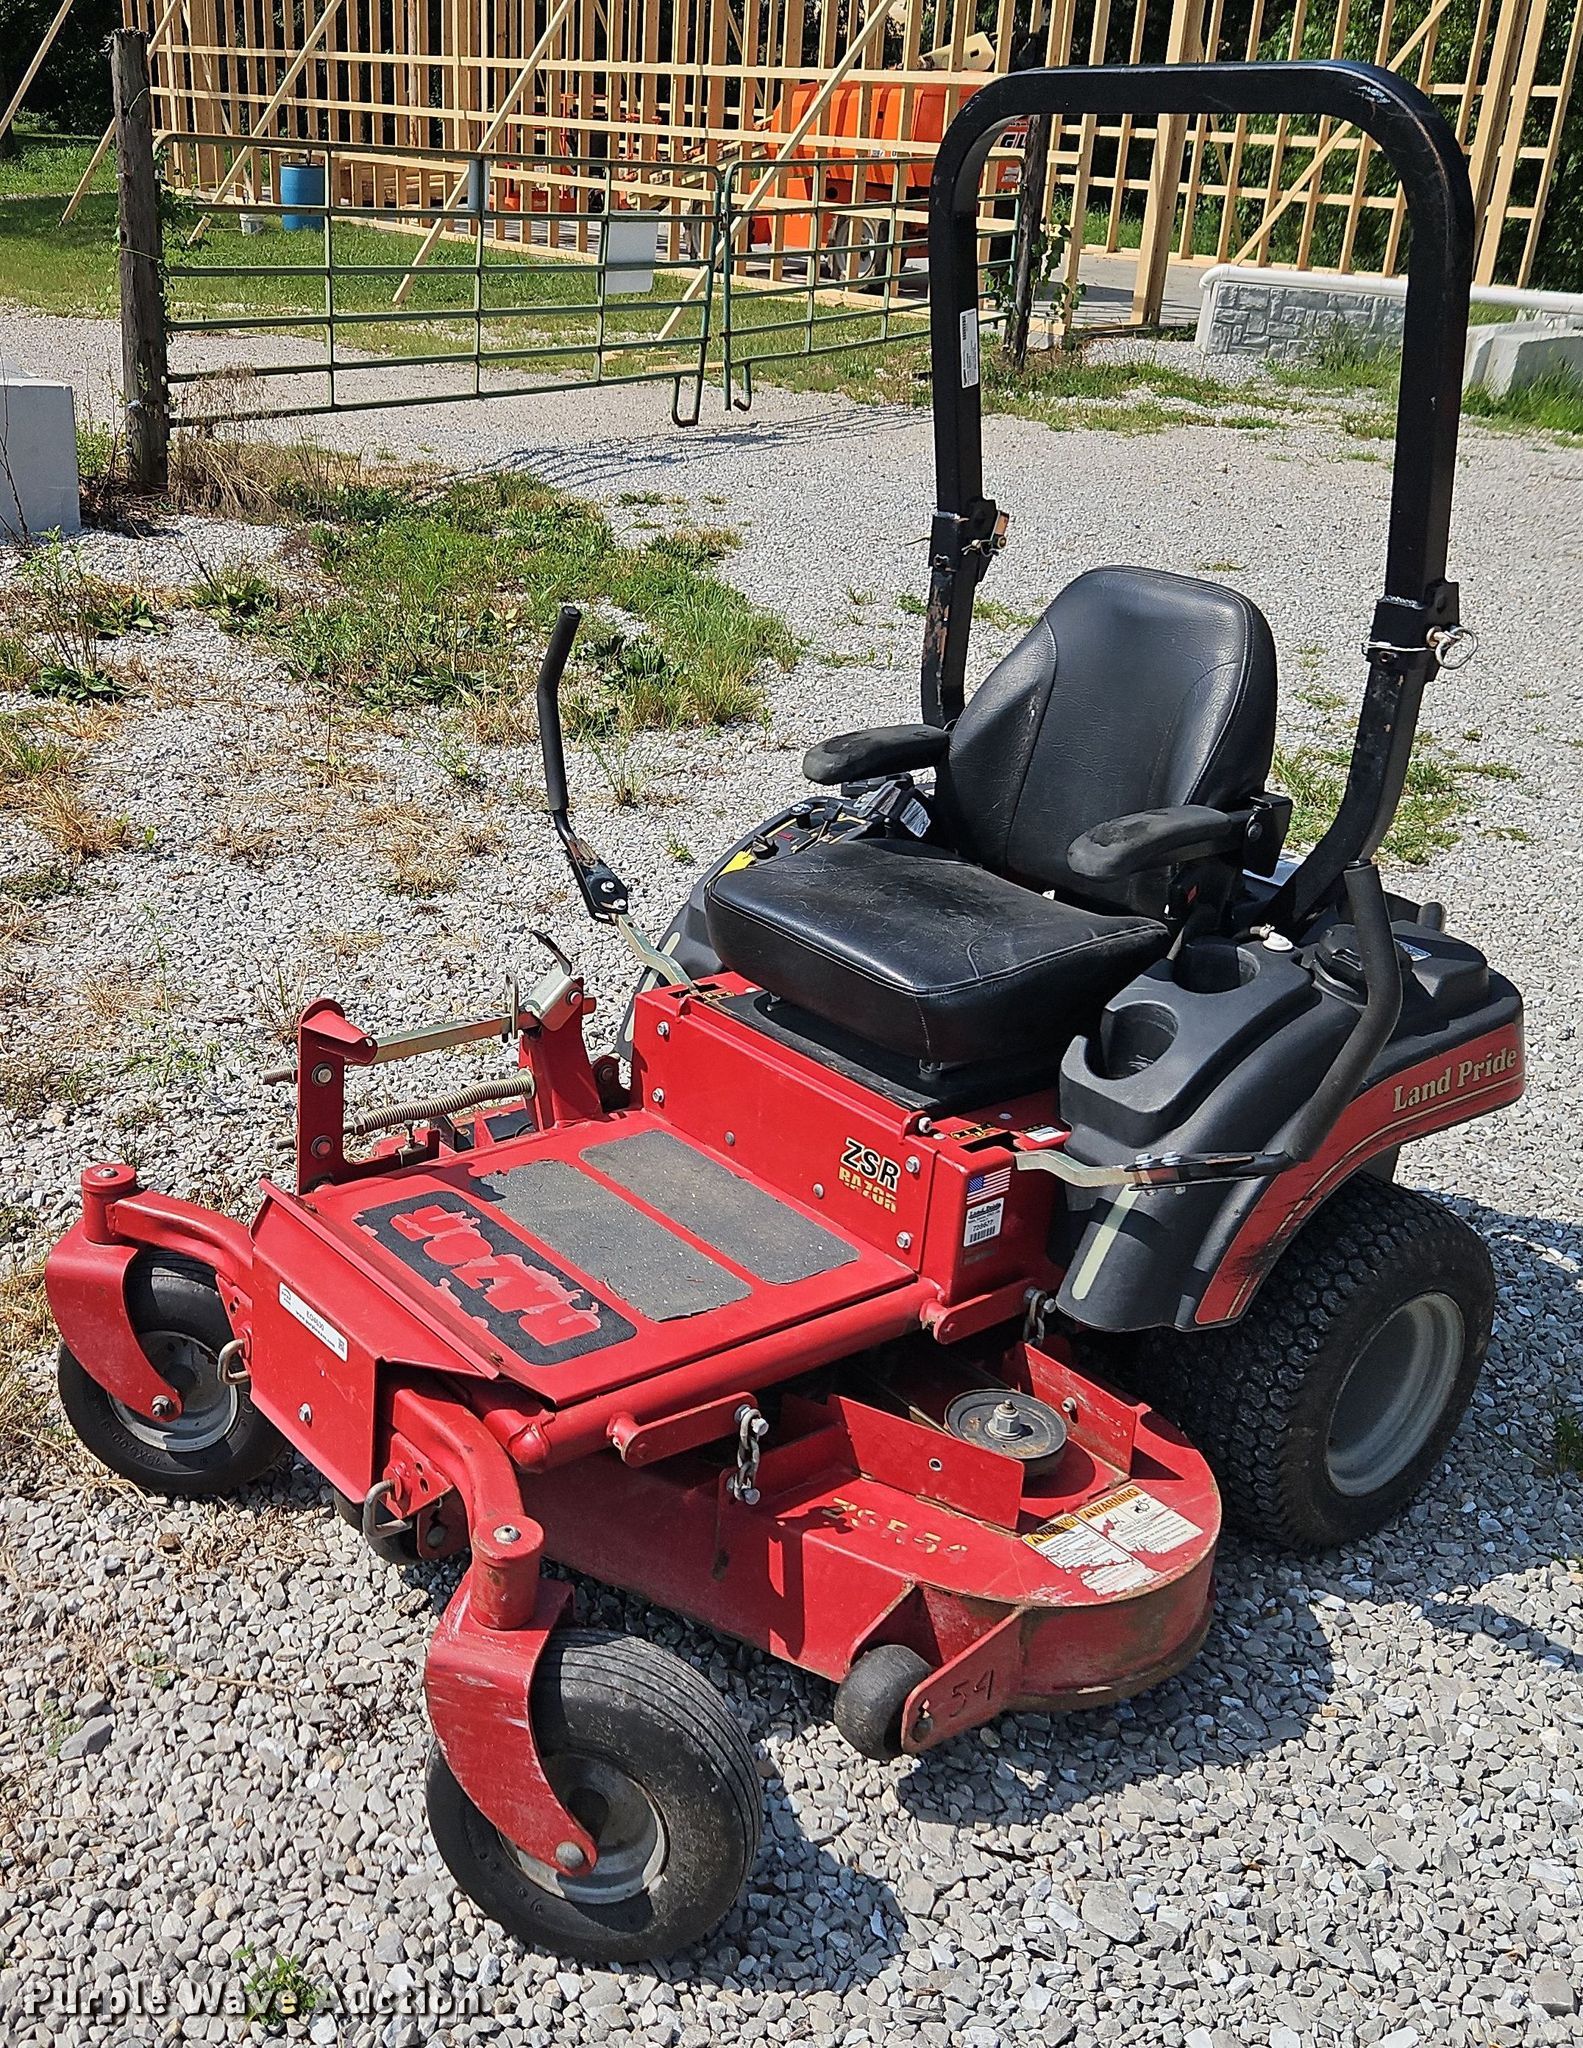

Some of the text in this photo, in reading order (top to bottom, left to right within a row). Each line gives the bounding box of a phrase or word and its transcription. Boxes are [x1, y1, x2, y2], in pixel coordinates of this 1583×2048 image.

[1393, 1048, 1517, 1112] Land Pride
[840, 1136, 901, 1193] ZSR
[838, 1166, 897, 1214] RAZOR
[1091, 1487, 1140, 1516] WARNING
[949, 1670, 994, 1718] 54
